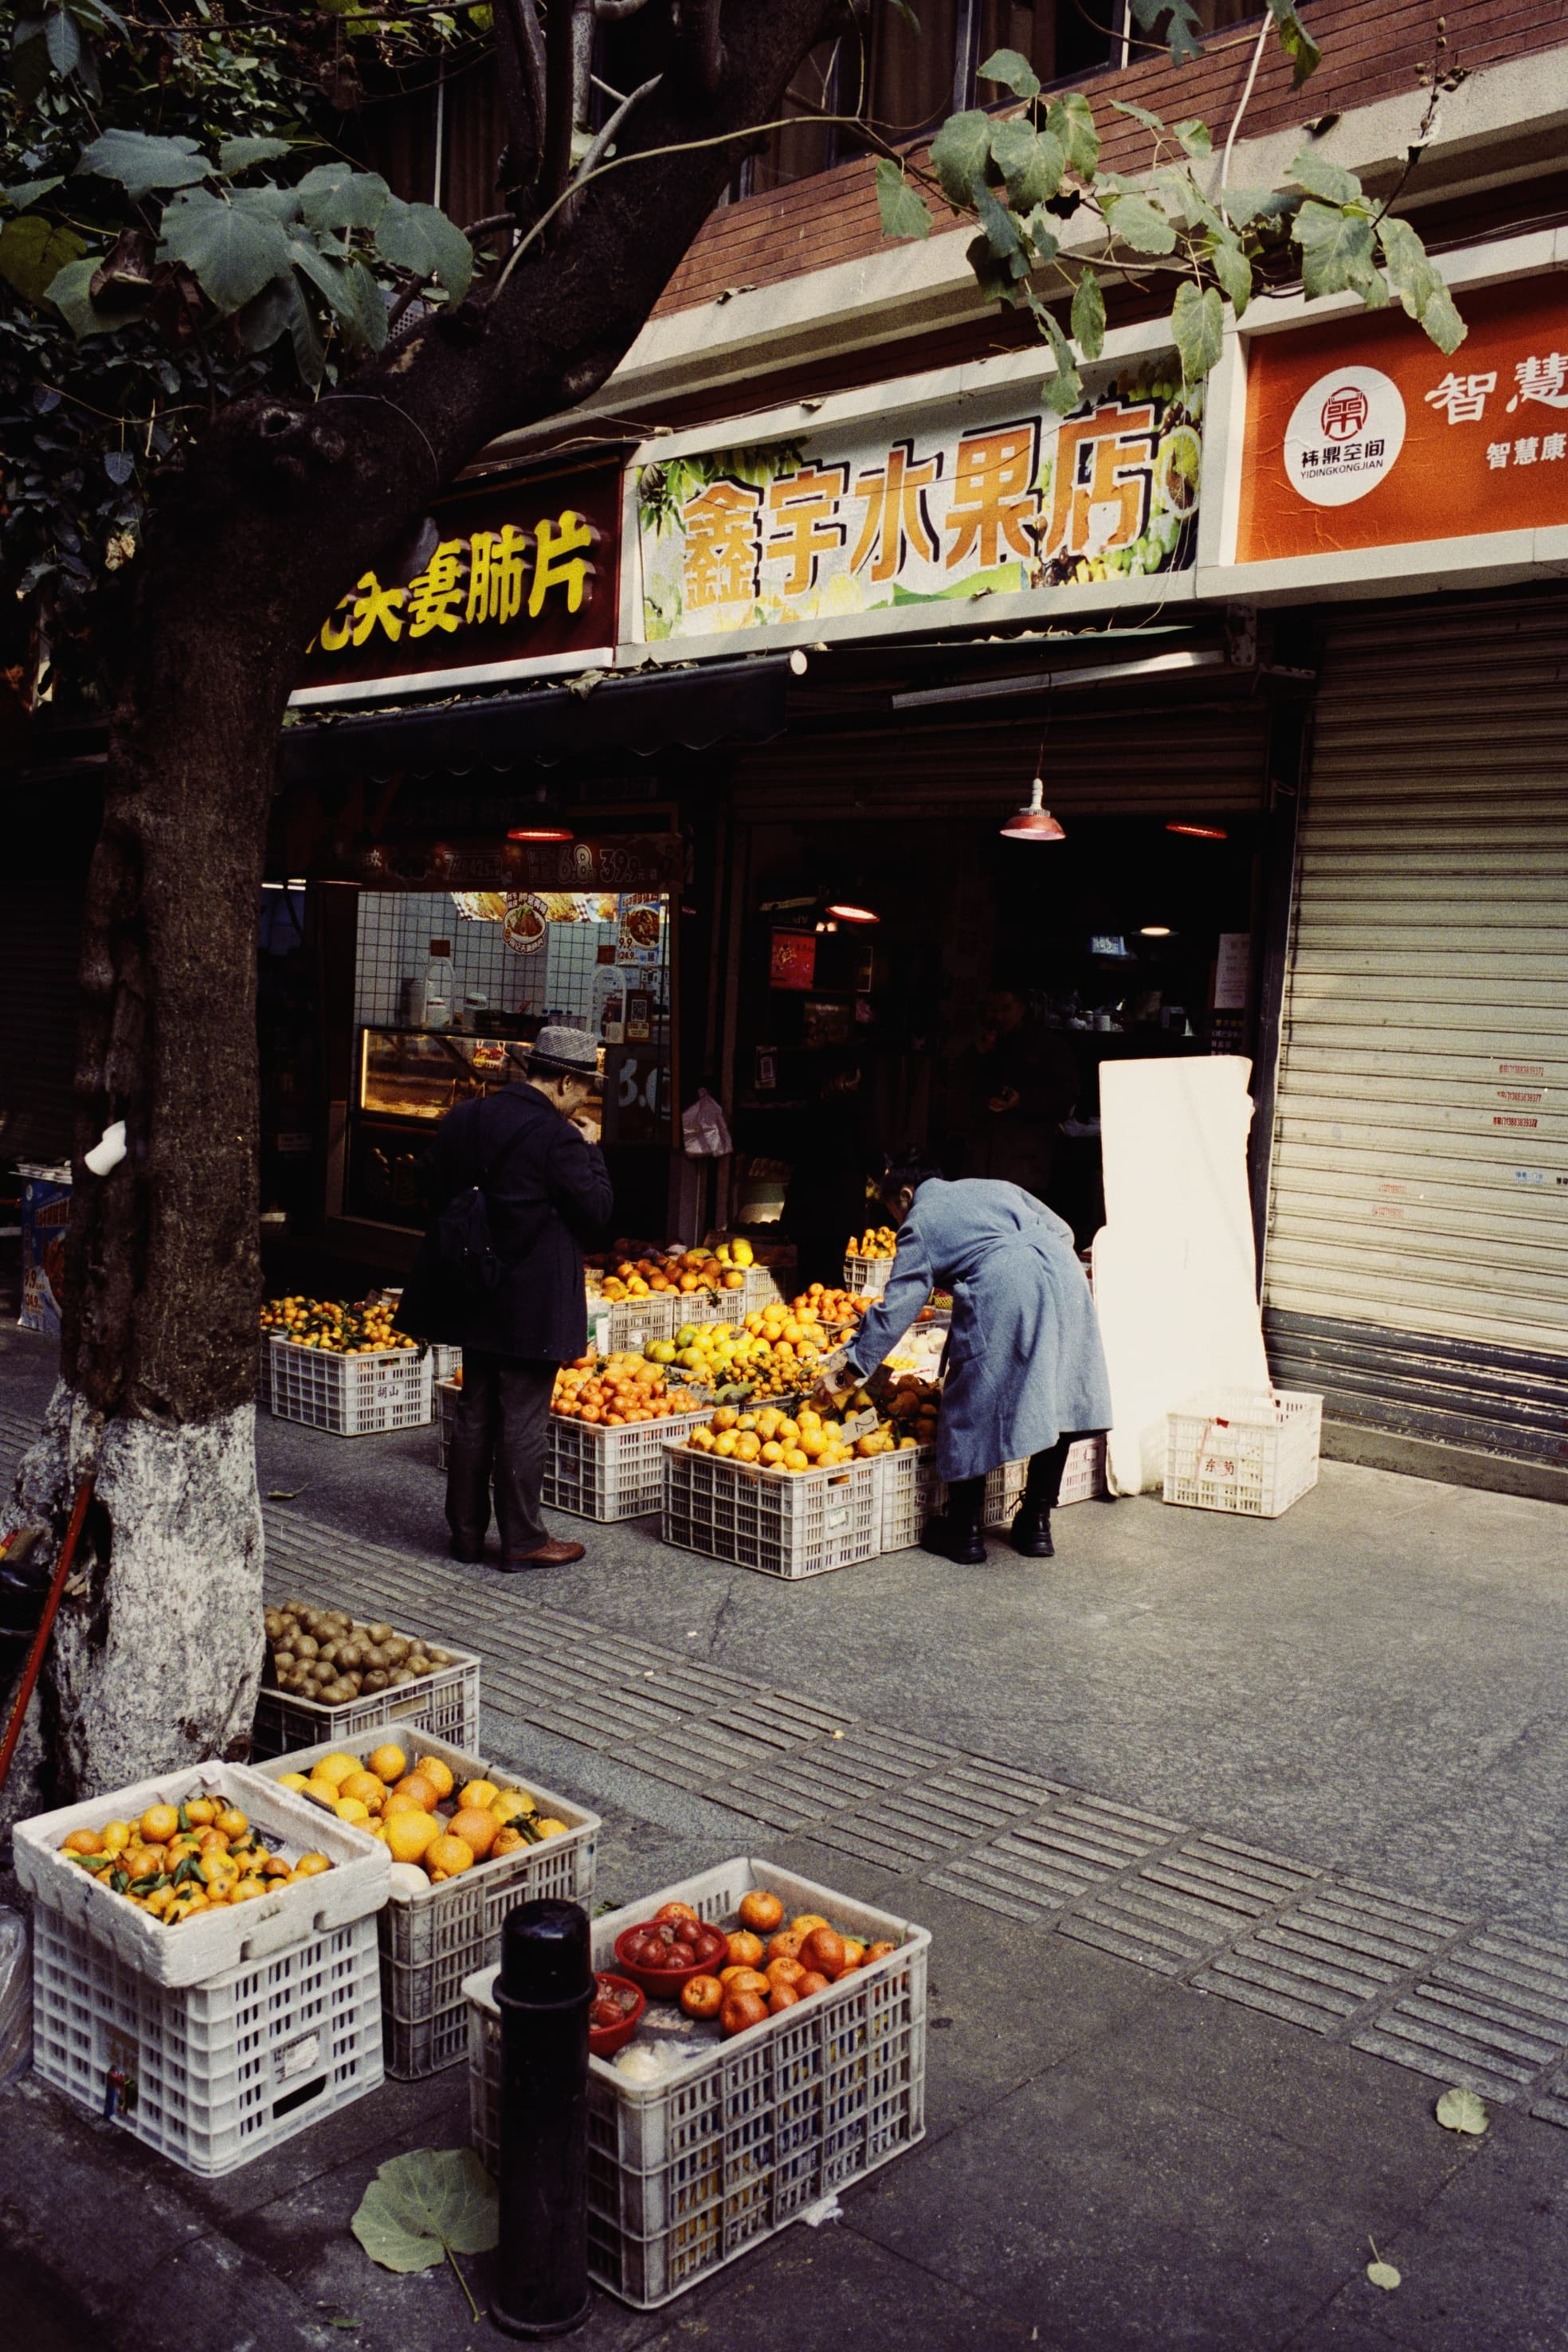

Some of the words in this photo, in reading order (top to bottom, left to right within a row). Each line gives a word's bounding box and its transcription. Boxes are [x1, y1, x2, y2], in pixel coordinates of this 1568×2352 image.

[682, 400, 1159, 610] 鑫宇水果店
[1300, 459, 1384, 480] YIDINGKONGJIAN
